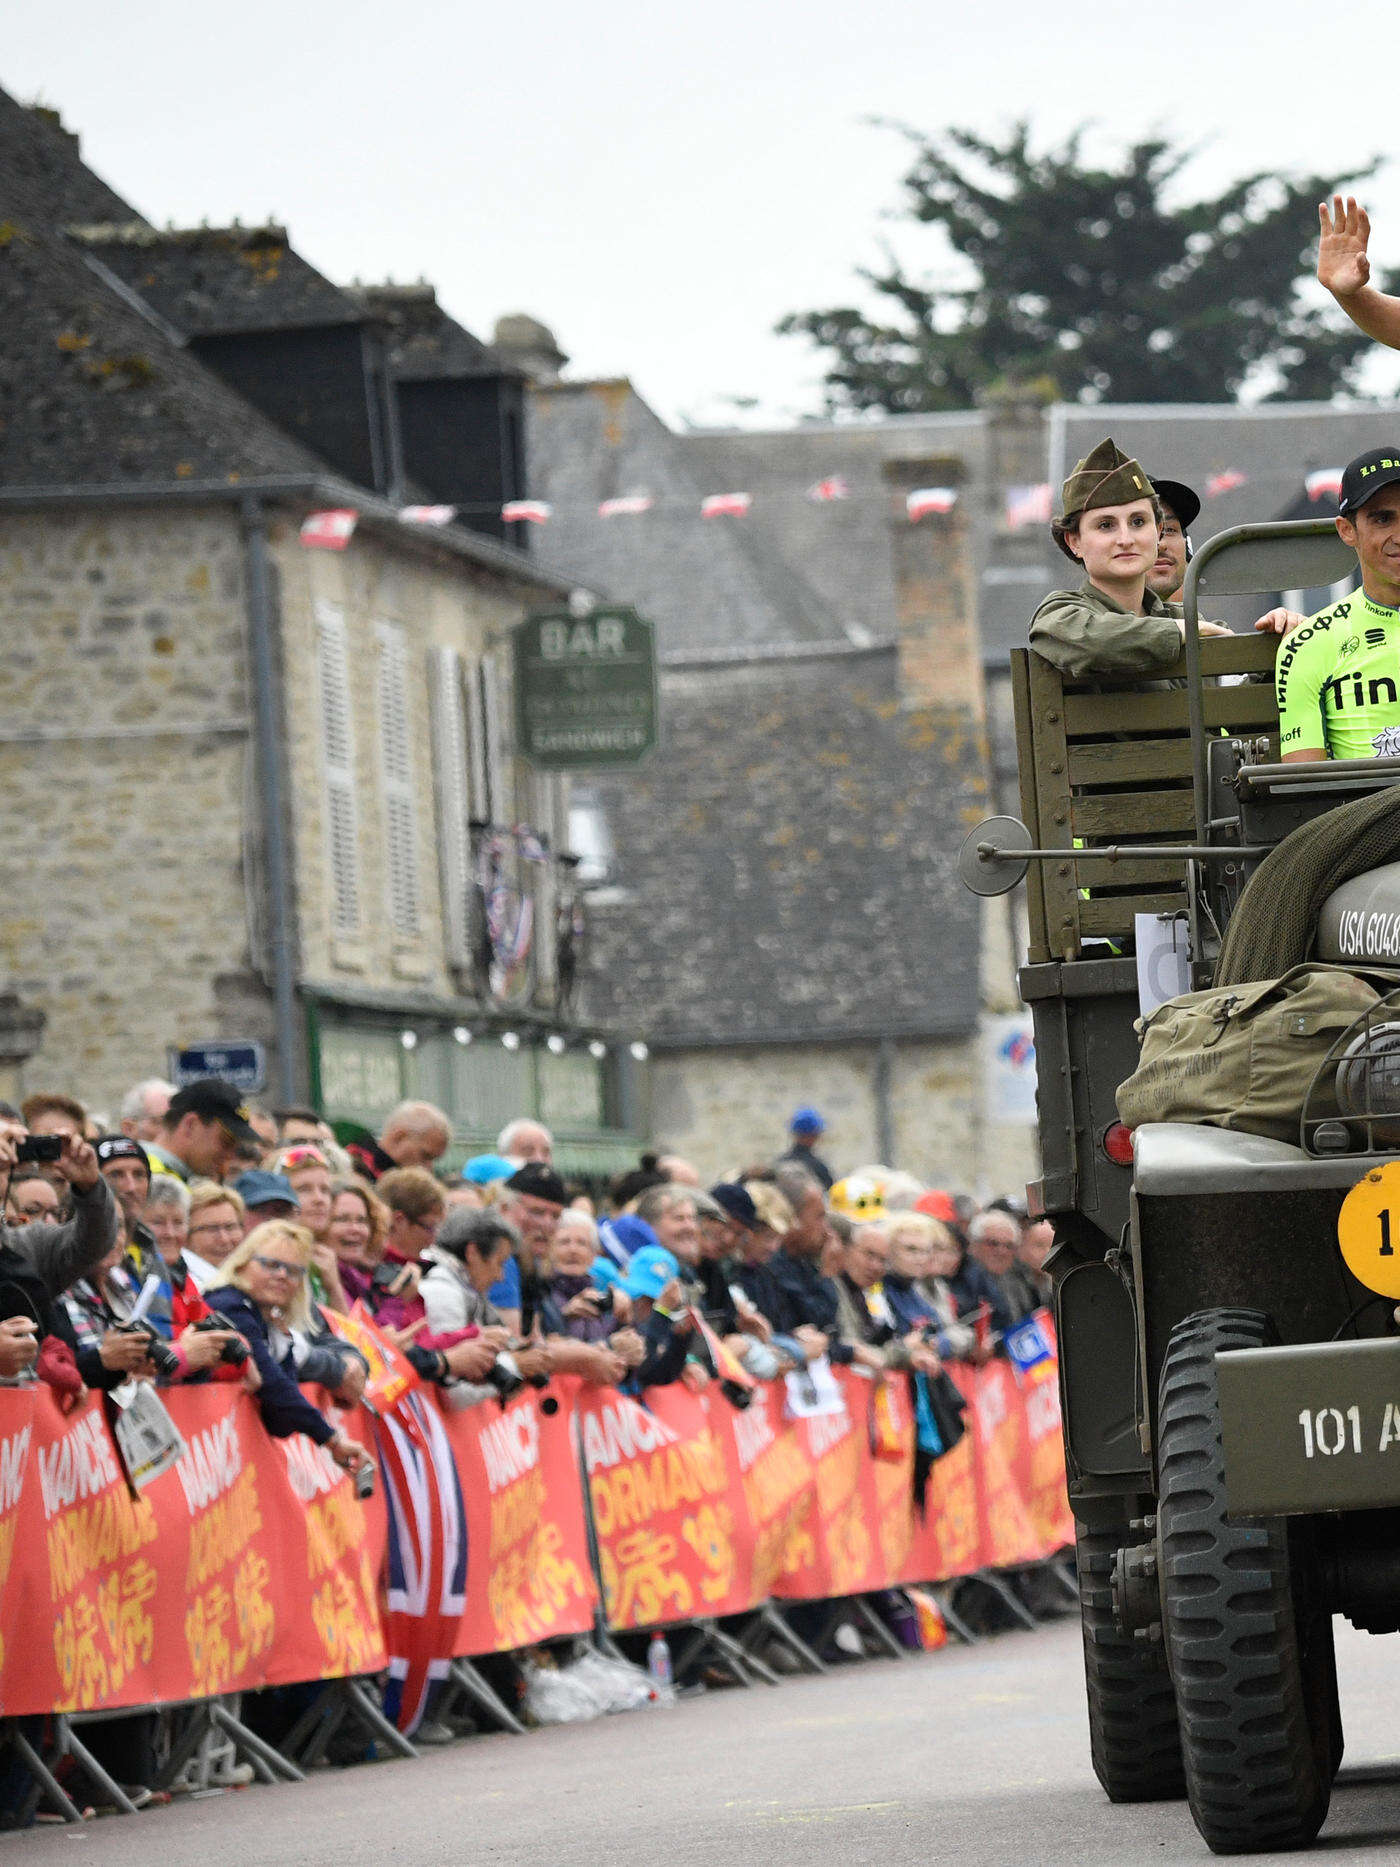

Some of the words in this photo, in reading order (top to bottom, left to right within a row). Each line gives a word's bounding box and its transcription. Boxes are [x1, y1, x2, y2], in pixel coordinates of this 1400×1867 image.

[1364, 602, 1394, 618] Tinkoff
[540, 619, 625, 660] BAR
[1281, 727, 1302, 743] koff
[1339, 911, 1366, 956] USA
[1298, 1404, 1362, 1458] 101
